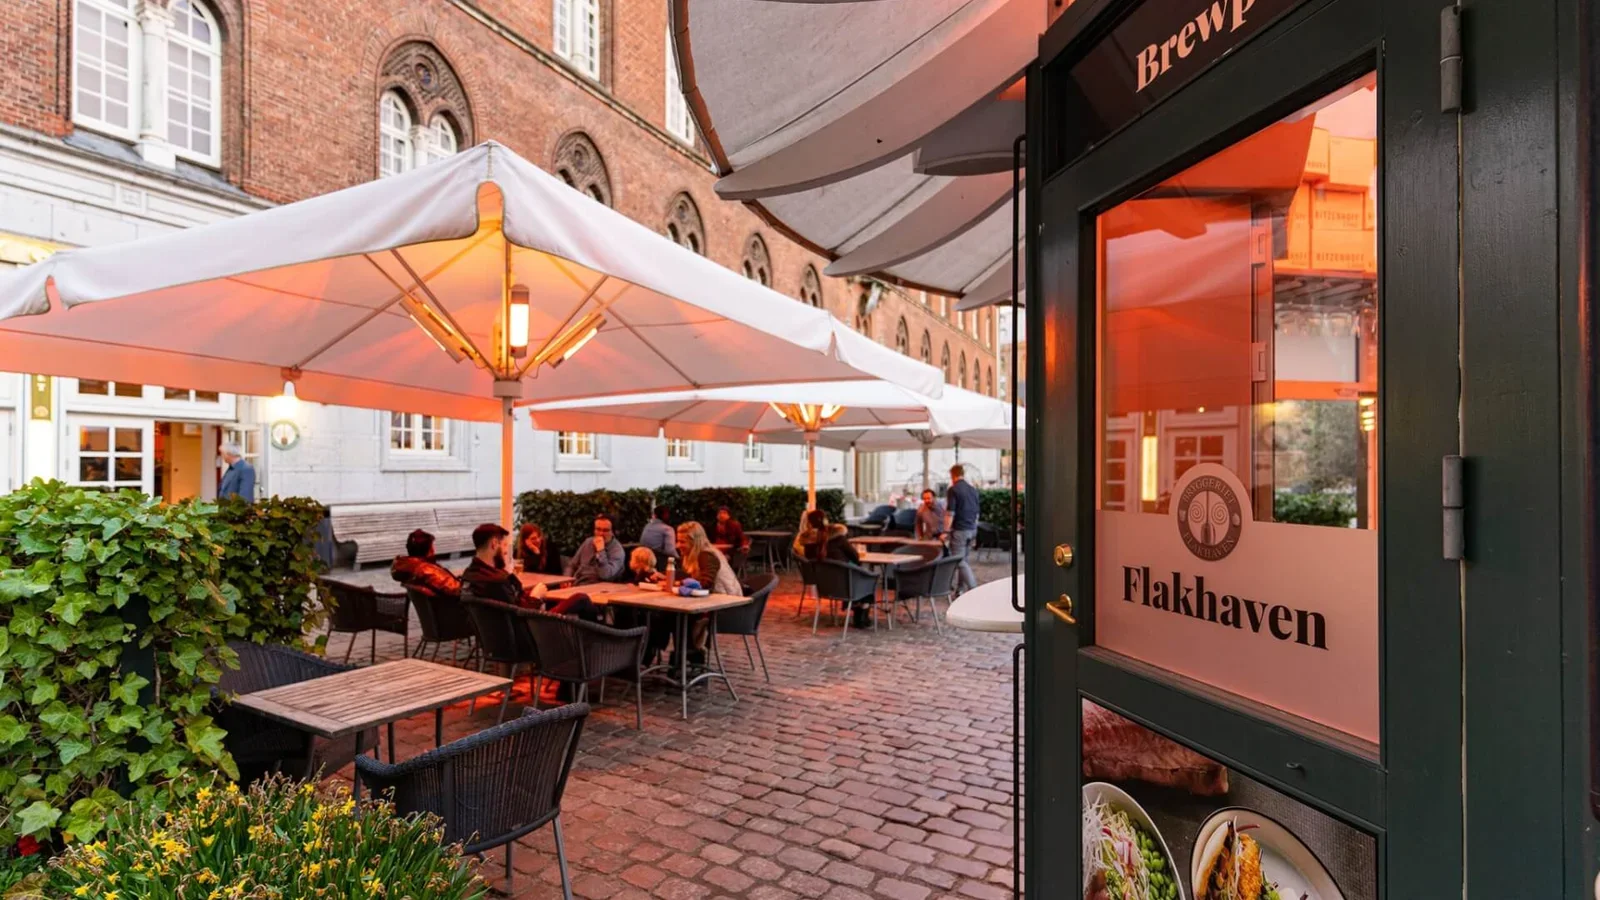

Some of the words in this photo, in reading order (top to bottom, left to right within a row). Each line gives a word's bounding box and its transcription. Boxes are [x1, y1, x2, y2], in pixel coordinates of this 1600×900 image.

[1182, 478, 1236, 504] BRYGGERIET
[1183, 531, 1235, 558] FLAKHAVEN
[1122, 565, 1329, 651] Flakhaven
